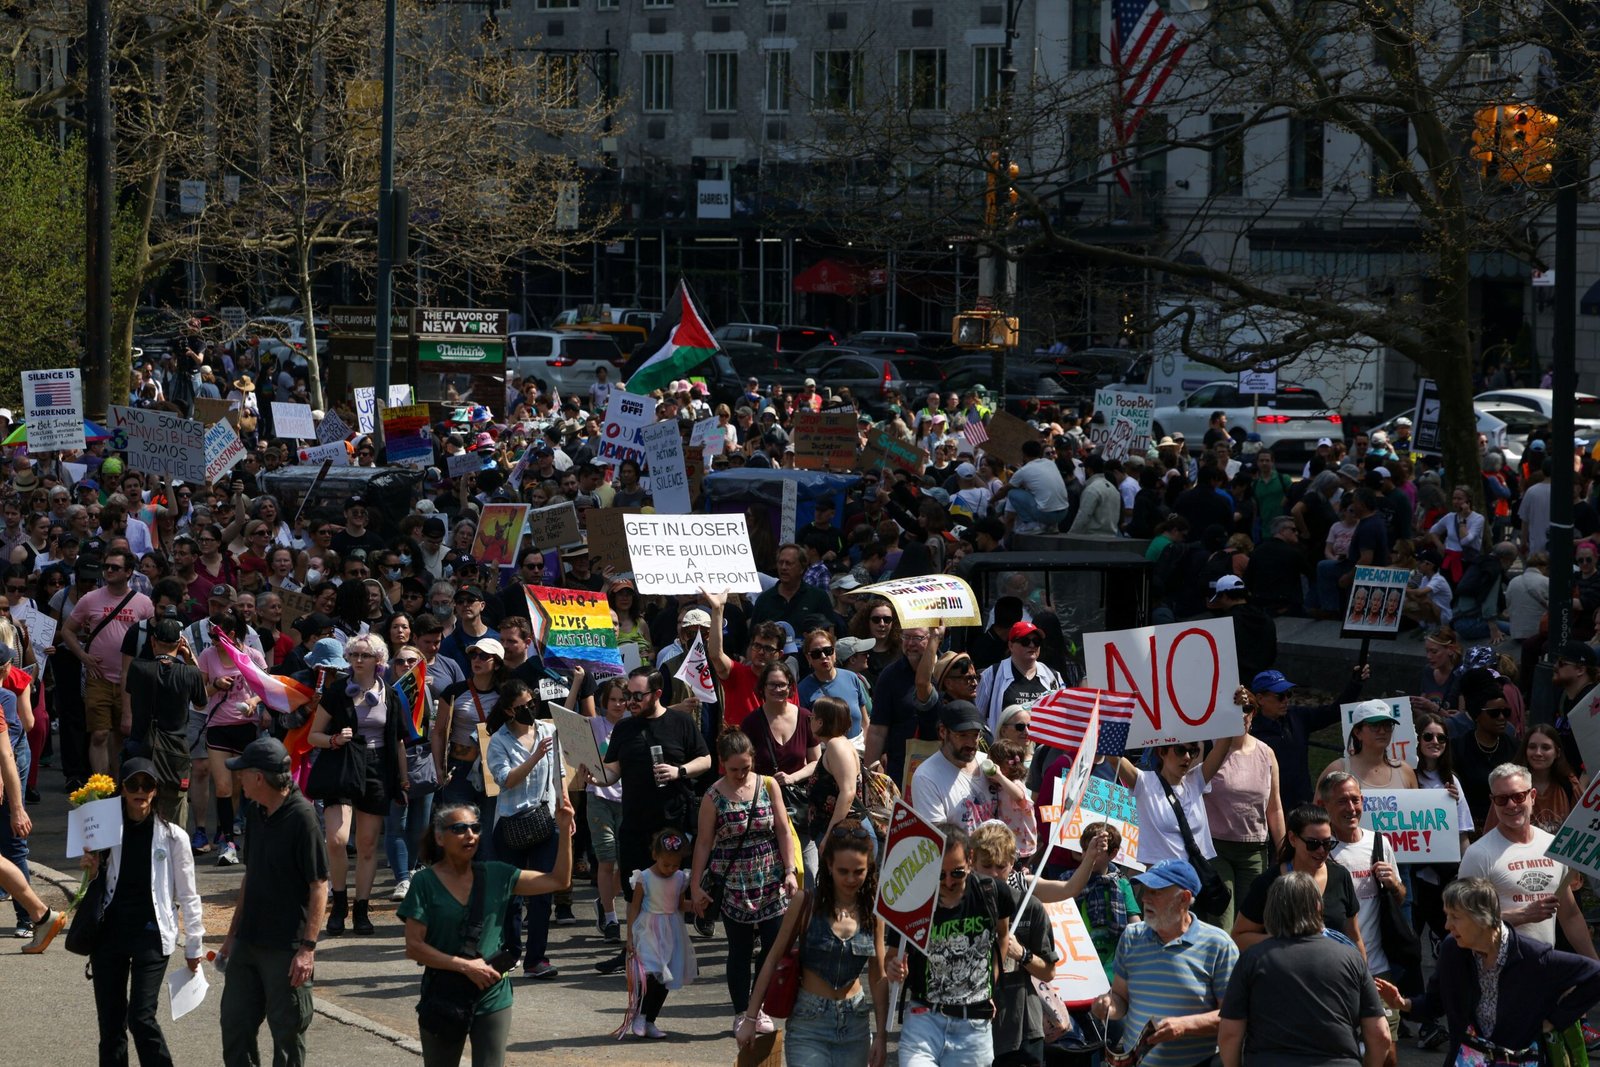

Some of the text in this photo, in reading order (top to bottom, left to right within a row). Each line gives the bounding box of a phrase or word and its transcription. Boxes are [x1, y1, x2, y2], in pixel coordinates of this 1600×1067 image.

[334, 316, 344, 324] THE
[423, 311, 499, 321] THE FLAVOR OF
[422, 321, 455, 333] NEW
[437, 344, 486, 360] Nathan's
[28, 371, 75, 381] SILENCE IS
[622, 399, 644, 408] HANDS
[1098, 393, 1112, 406] No
[30, 408, 76, 417] SURRENDER
[621, 405, 643, 416] OFF!
[1120, 408, 1150, 418] LARGE
[128, 410, 202, 437] NO SOMOS
[128, 423, 202, 449] INVISIBLES
[143, 441, 188, 461] SOMOS
[656, 447, 677, 460] ACTIONS
[207, 438, 244, 479] RESISTANCE
[129, 452, 204, 481] INVENCIBLES
[652, 466, 664, 476] But
[656, 472, 684, 490] SILENCE
[626, 522, 658, 536] GET
[629, 543, 748, 556] WE'RE BUILDING
[687, 558, 697, 568] A
[635, 571, 756, 584] POPULAR FRONT
[1355, 568, 1410, 583] IMPEACH NOW
[886, 581, 964, 595] LOVE MUST BE
[547, 592, 598, 608] LGBTQ+
[553, 615, 589, 630] LIVES
[556, 633, 606, 647] MATTER!
[1104, 628, 1219, 730] NO
[1370, 808, 1449, 831] KILMAR
[1508, 858, 1554, 871] GET MITCH
[882, 840, 940, 906] CAPITALISM
[1513, 894, 1523, 902] OR
